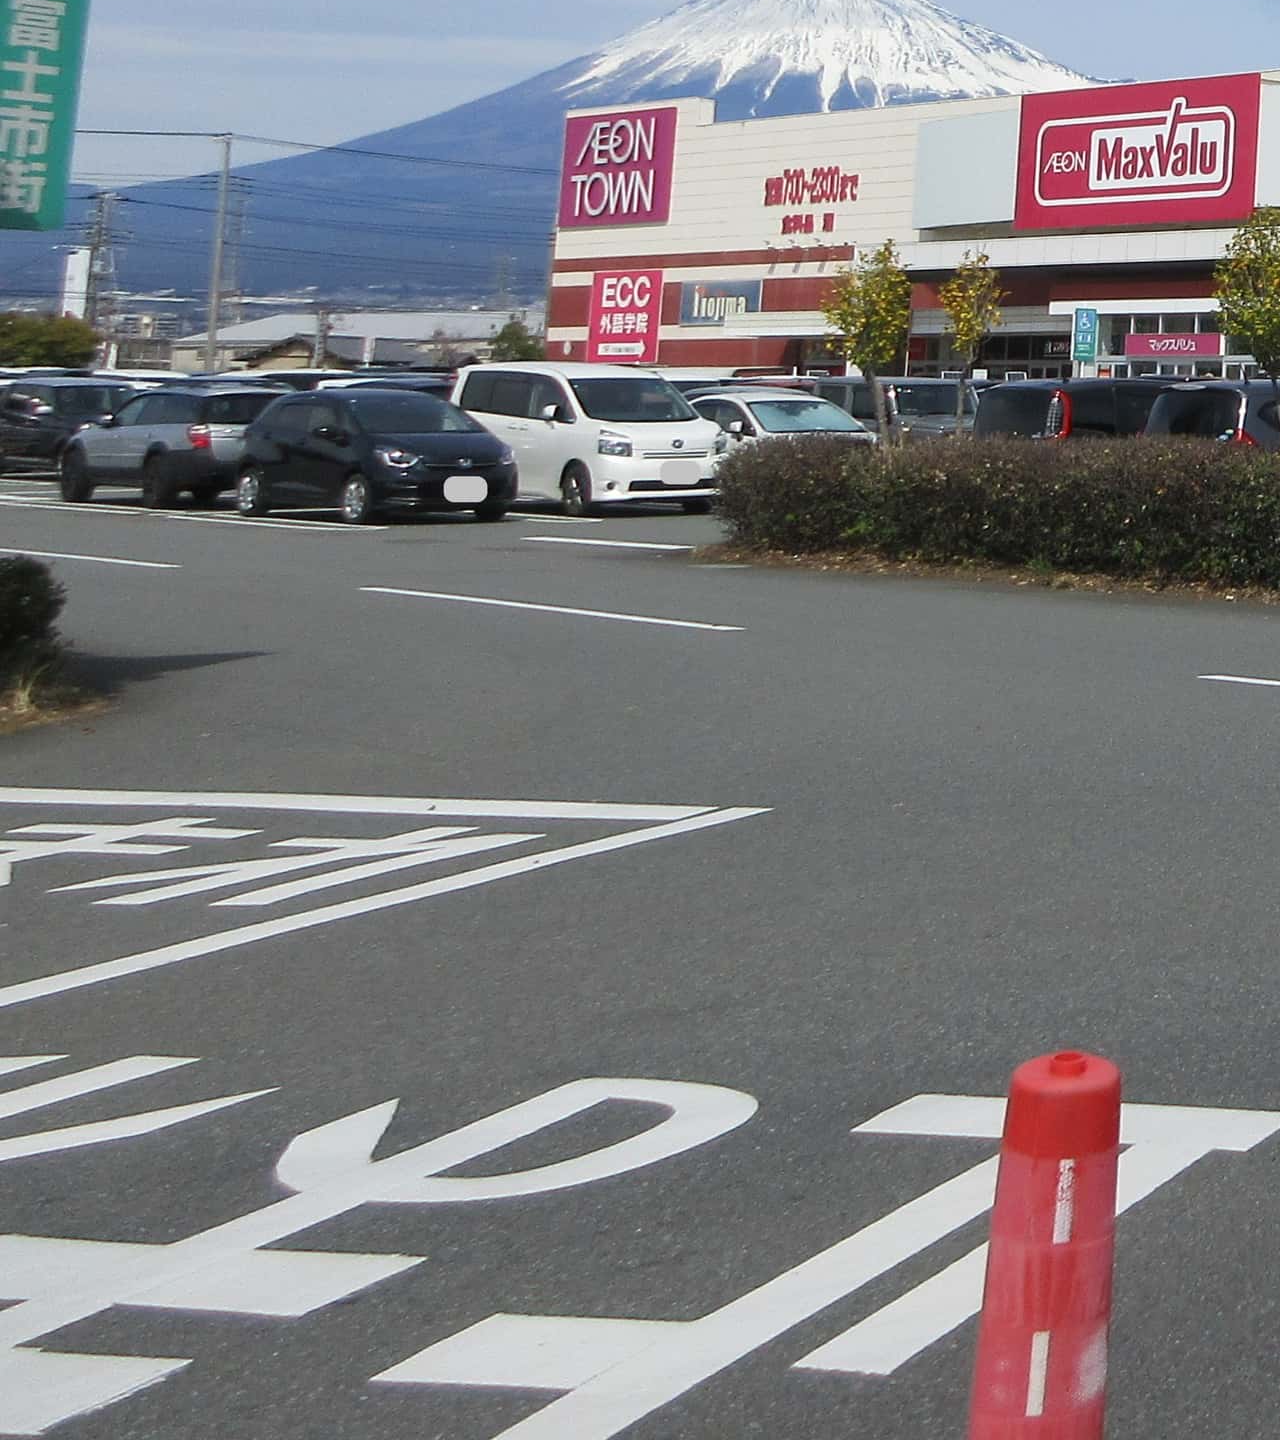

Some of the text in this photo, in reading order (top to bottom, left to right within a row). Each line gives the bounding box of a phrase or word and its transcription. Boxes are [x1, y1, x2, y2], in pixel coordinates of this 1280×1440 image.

[1097, 103, 1217, 181] MaxValu
[571, 169, 654, 217] TOWN
[602, 276, 651, 308] ECC
[600, 312, 649, 334] 外語学院
[1149, 339, 1196, 351] マックスバリュ
